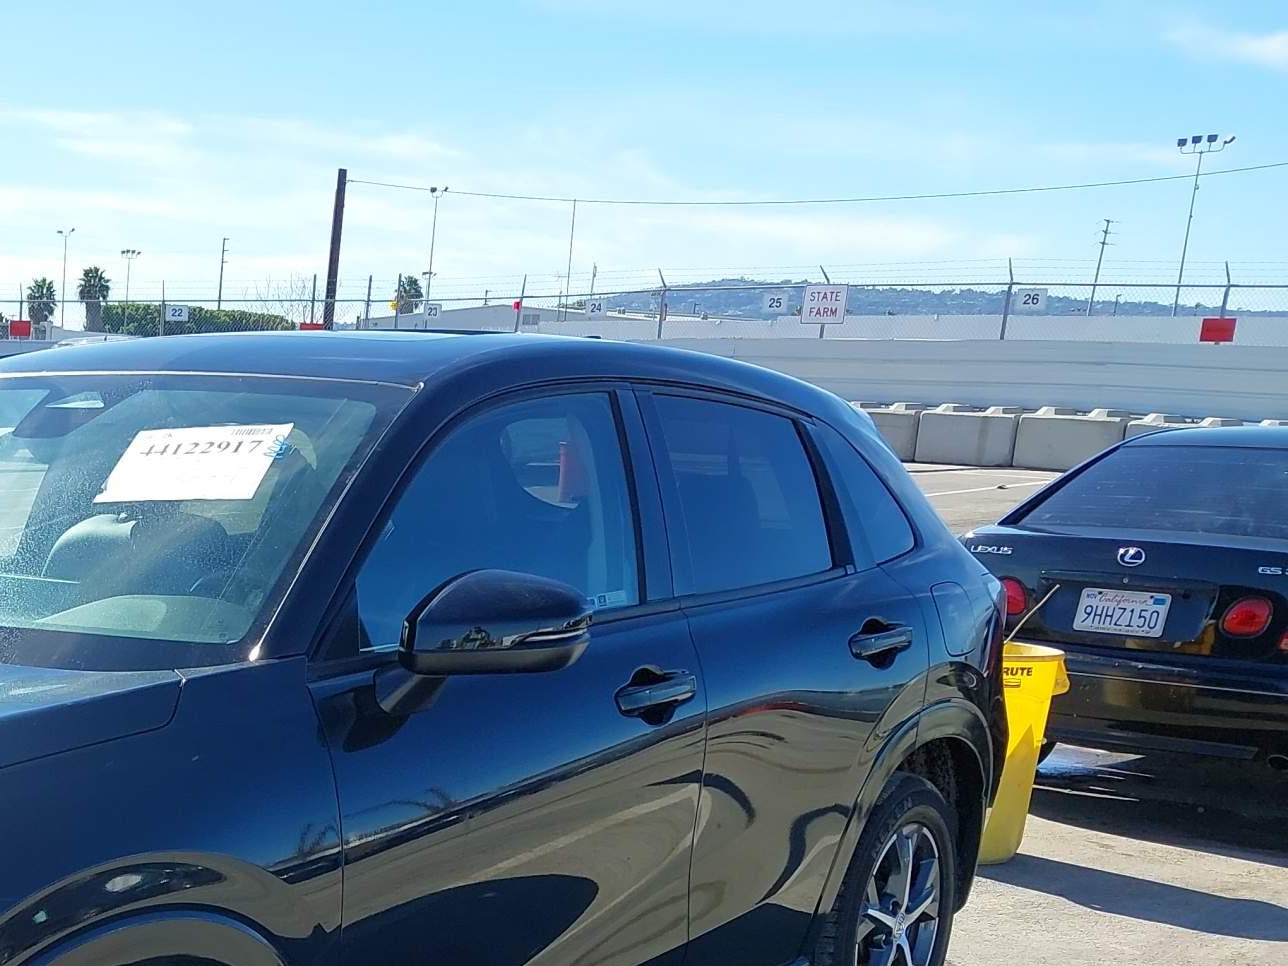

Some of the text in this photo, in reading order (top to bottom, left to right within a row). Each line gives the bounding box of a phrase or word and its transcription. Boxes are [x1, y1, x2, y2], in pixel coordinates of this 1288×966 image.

[809, 290, 842, 302] STATE
[1022, 293, 1040, 305] 26
[590, 303, 602, 313] 24
[768, 297, 783, 309] 25
[171, 308, 183, 317] 22
[808, 306, 838, 318] FARM
[140, 440, 263, 457] 44122917
[970, 545, 1014, 555] LEXUS
[1258, 566, 1283, 575] GS
[1080, 604, 1160, 630] 9HHZ150
